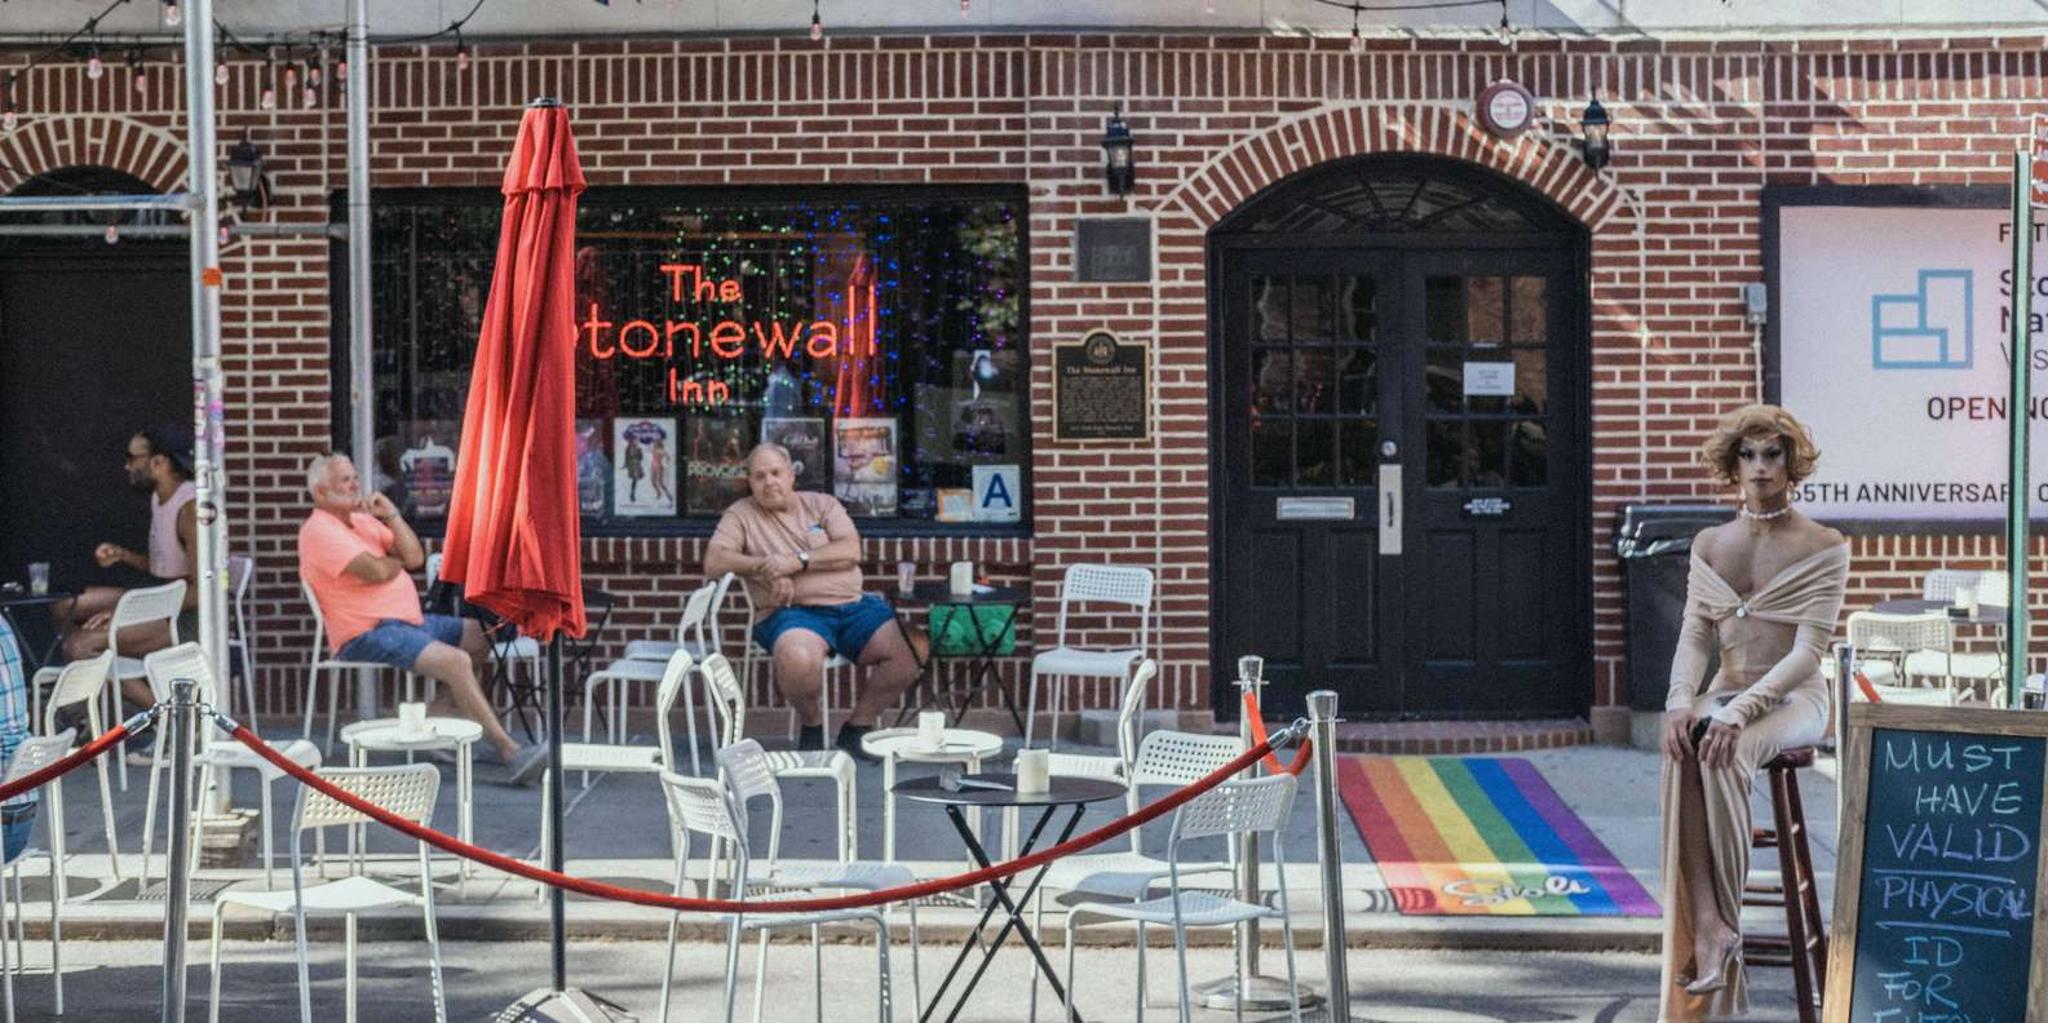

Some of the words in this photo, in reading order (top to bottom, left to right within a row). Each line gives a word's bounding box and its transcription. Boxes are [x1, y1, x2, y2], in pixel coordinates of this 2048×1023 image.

[660, 264, 742, 302] The
[574, 284, 876, 359] tonewall
[669, 367, 730, 405] Inn
[982, 473, 1013, 508] A
[1856, 483, 2009, 503] ANNIVERSAR
[1884, 737, 2022, 773] MUST
[1914, 782, 2023, 816] HAVE
[1885, 822, 2032, 863] VALID
[1876, 875, 2033, 920] PHYSICAL
[1903, 935, 1964, 967] ID
[1876, 971, 1958, 1010] FOR
